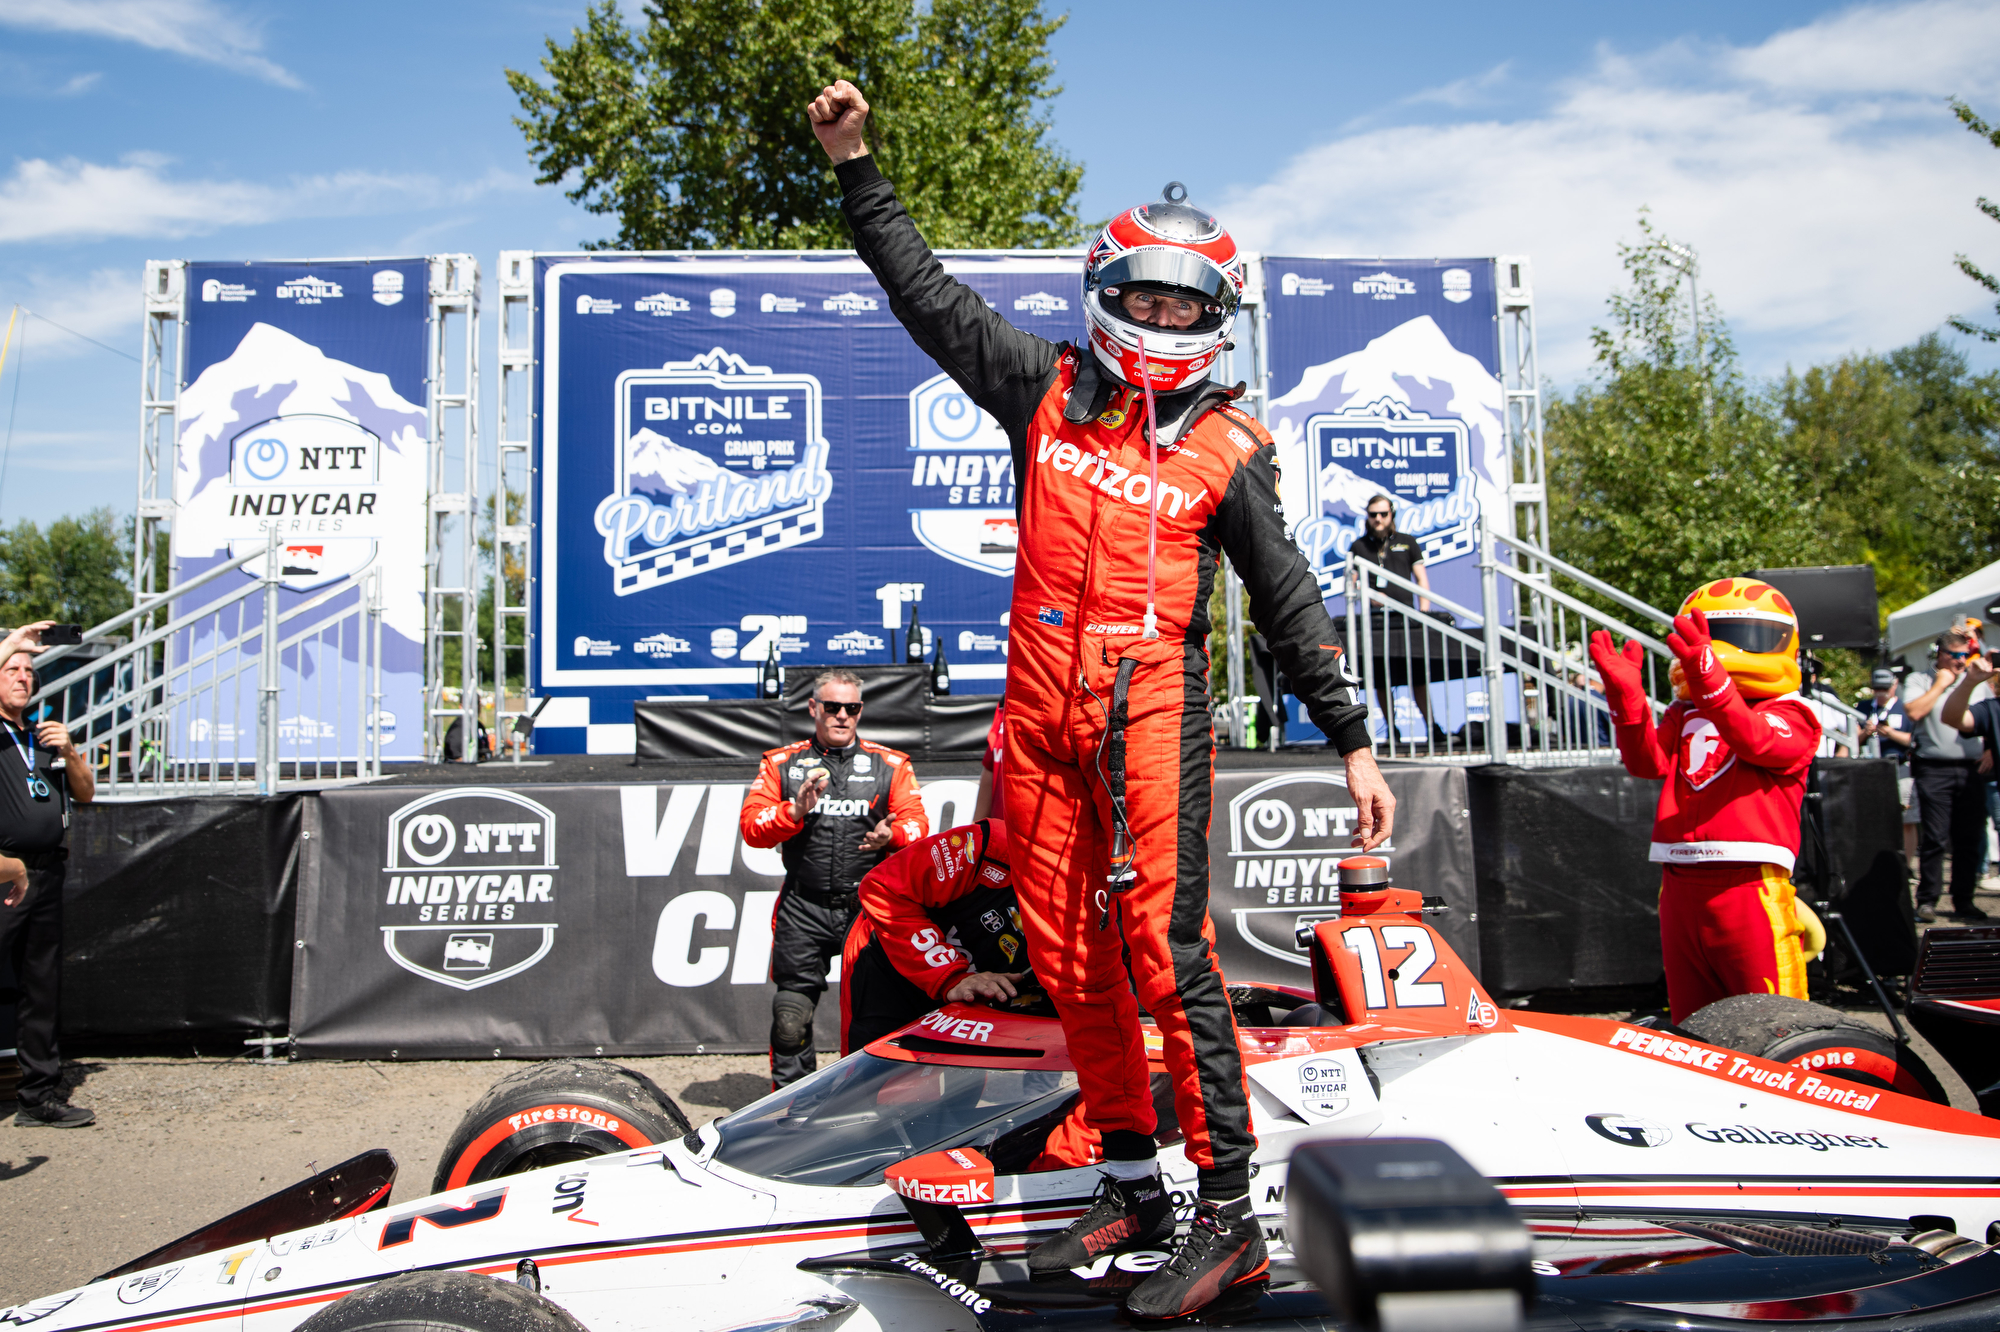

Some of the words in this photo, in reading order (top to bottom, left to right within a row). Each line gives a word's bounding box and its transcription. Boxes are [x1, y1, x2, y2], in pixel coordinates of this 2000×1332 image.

[277, 285, 343, 298] BITNILE
[1353, 281, 1416, 294] BITNILE
[635, 301, 691, 311] BITNILE
[823, 301, 879, 311] BITNILE
[1014, 300, 1069, 310] BITNILE
[645, 396, 792, 421] BITNILE
[687, 423, 743, 435] .COM
[725, 441, 765, 456] GRAND
[767, 440, 795, 456] PRIX
[1228, 429, 1253, 450] OMP
[1331, 437, 1446, 457] BITNILE
[300, 446, 366, 469] NTT
[752, 456, 767, 470] OF
[1365, 458, 1409, 469] .COM
[1036, 433, 1186, 518] verizon
[1395, 473, 1427, 487] GRAND
[1428, 473, 1450, 486] PRIX
[948, 486, 1013, 504] SERI
[1416, 486, 1428, 497] OF
[229, 493, 377, 516] INDYCAR
[604, 445, 826, 558] Portland
[259, 519, 343, 532] SERIES
[1085, 623, 1139, 634] POWER
[634, 641, 691, 653] BITNILE
[827, 639, 885, 651] BITNILE
[464, 823, 540, 853] NTT
[939, 837, 955, 879] SIEMENS
[1669, 848, 1726, 857] FIREHAWK
[983, 868, 1005, 881] OMP
[386, 874, 554, 905] INDYCAR
[1266, 887, 1339, 904] SERIE
[419, 904, 515, 921] SERIES
[1341, 925, 1447, 1010] 12
[1320, 1068, 1341, 1078] NTT
[1609, 1028, 1728, 1072] PENSKE
[1727, 1057, 1796, 1092] Truck
[1797, 1080, 1880, 1112] Rental
[1302, 1083, 1347, 1094] INDYCAR
[508, 1107, 619, 1132] Firestone
[1685, 1121, 1890, 1151] Gallagher
[898, 1176, 992, 1203] Mazak
[1081, 1214, 1142, 1257] PUMA
[890, 1252, 992, 1315] Firestone
